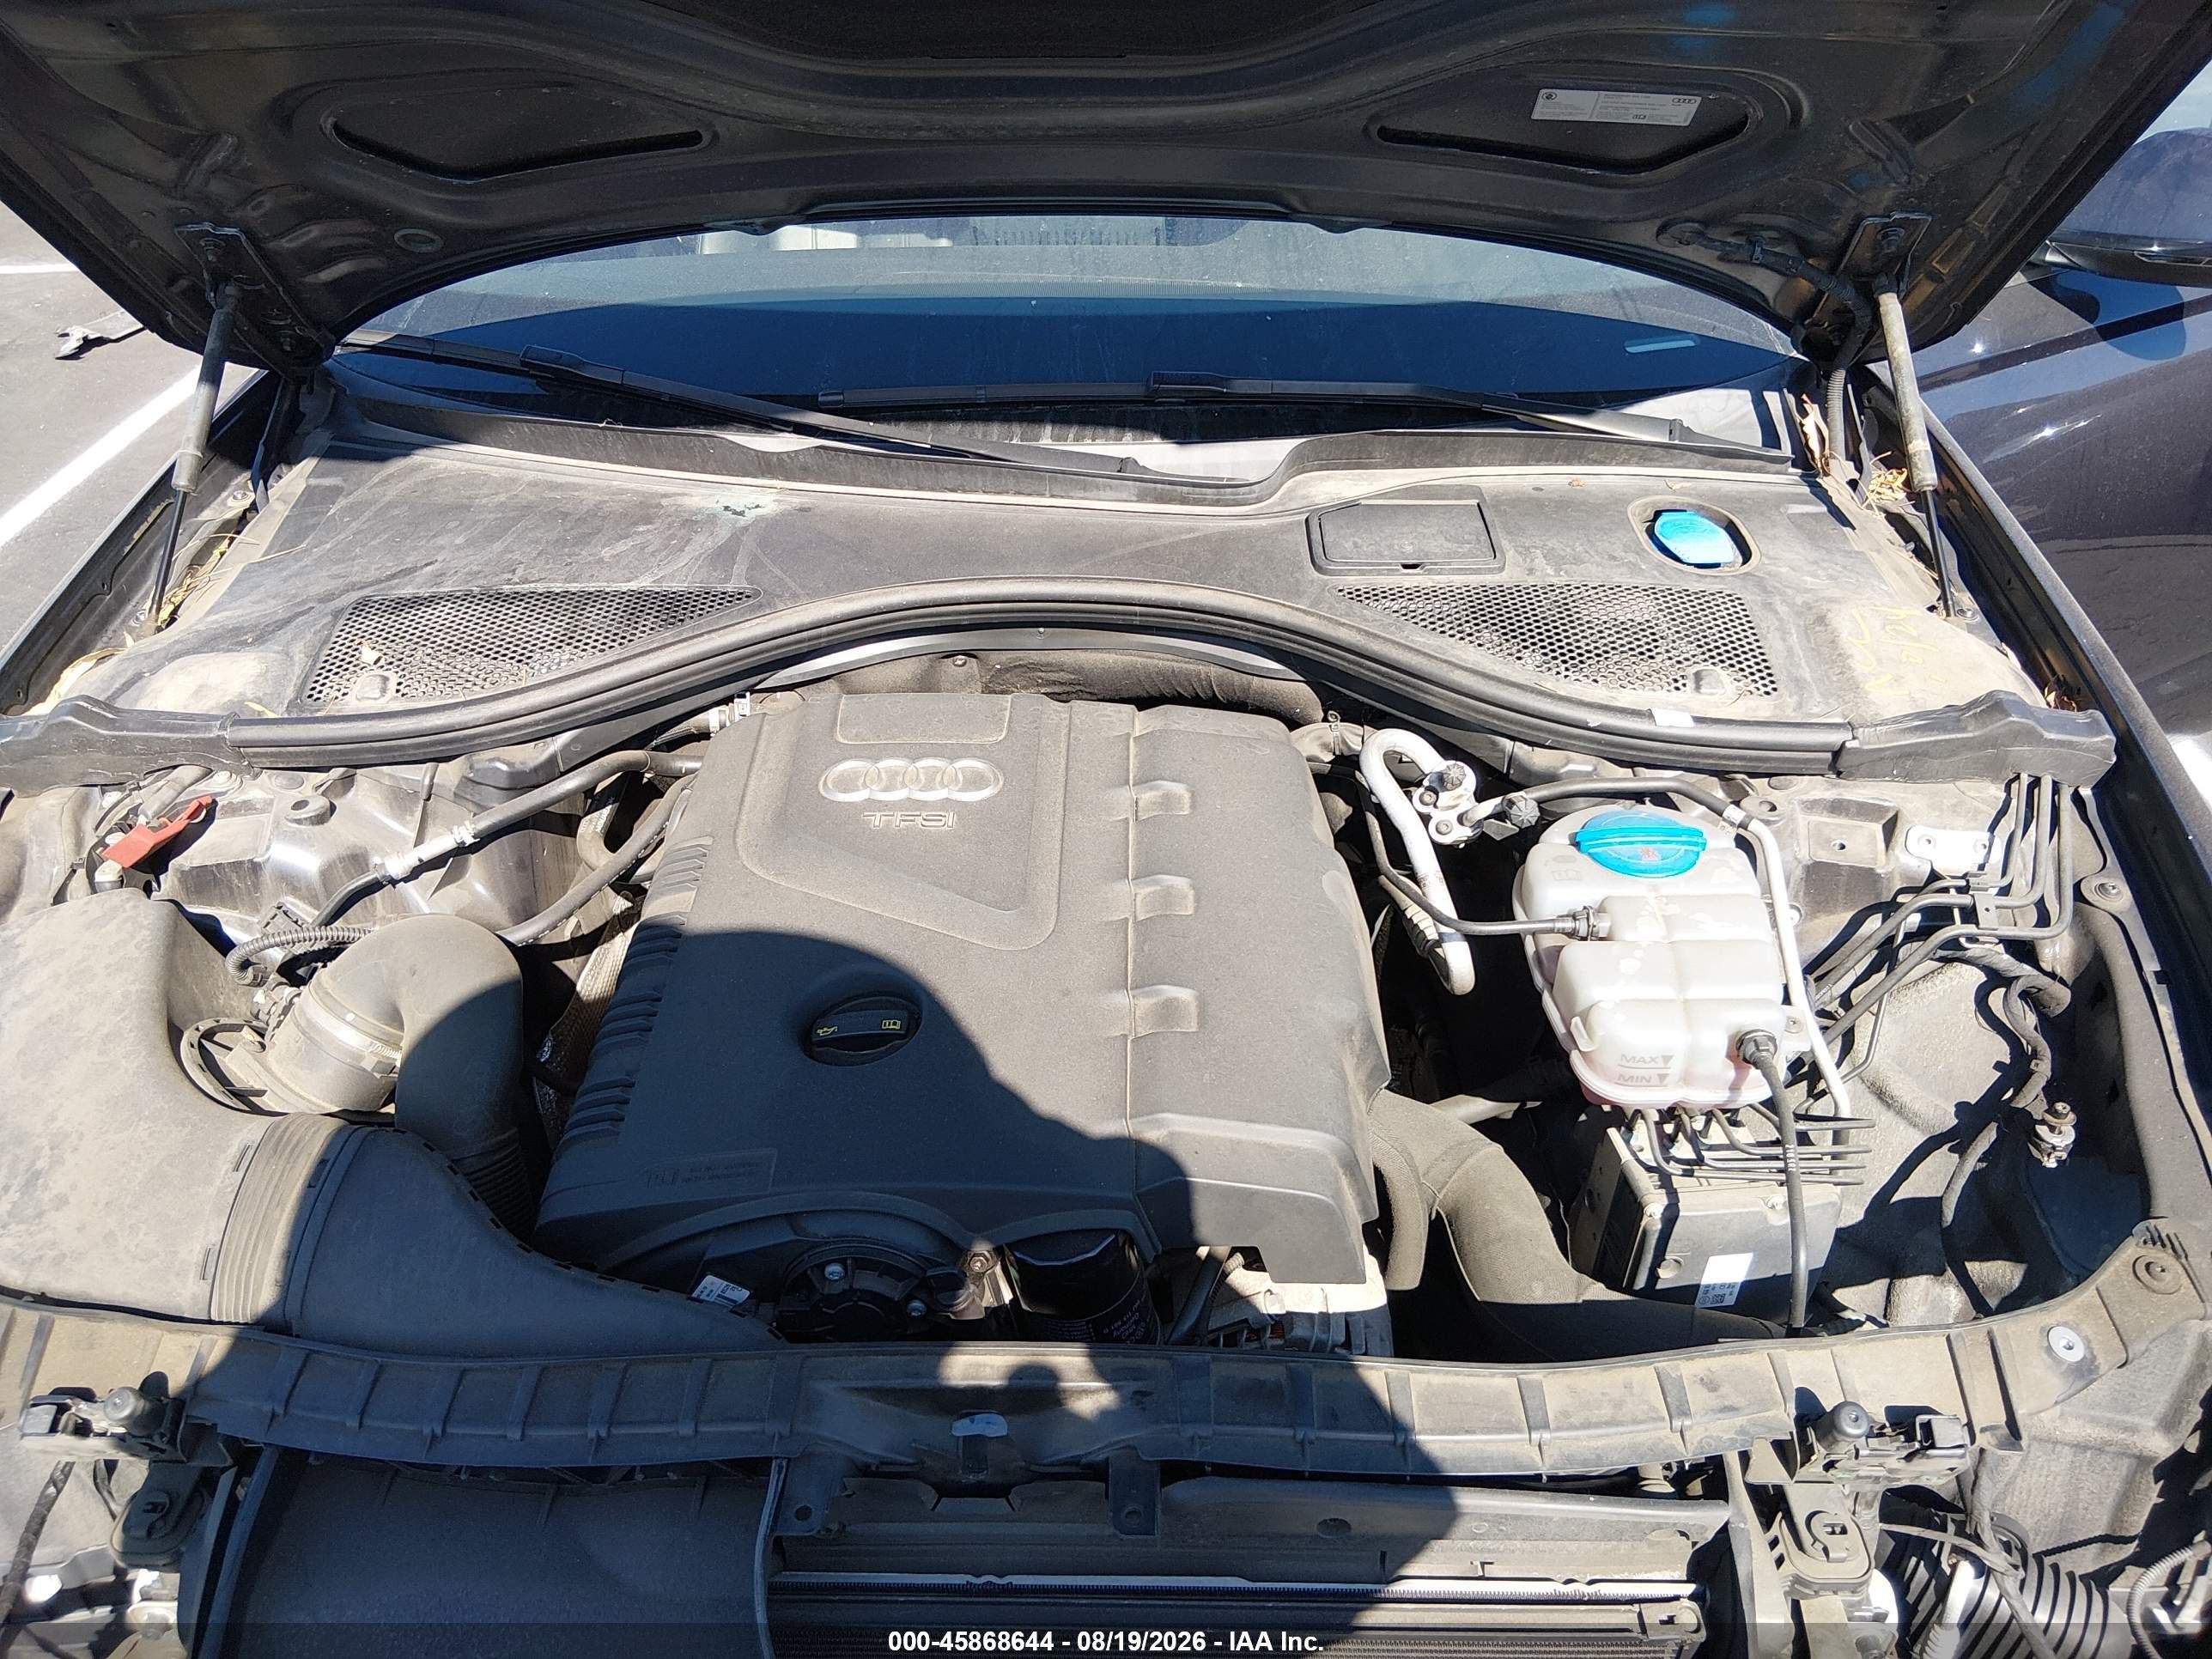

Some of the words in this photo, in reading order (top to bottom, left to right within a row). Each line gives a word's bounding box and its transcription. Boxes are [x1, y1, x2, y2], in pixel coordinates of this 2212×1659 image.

[862, 811, 956, 829] TFSI
[1620, 1054, 1659, 1065] MAX
[1617, 1073, 1652, 1084] MIN
